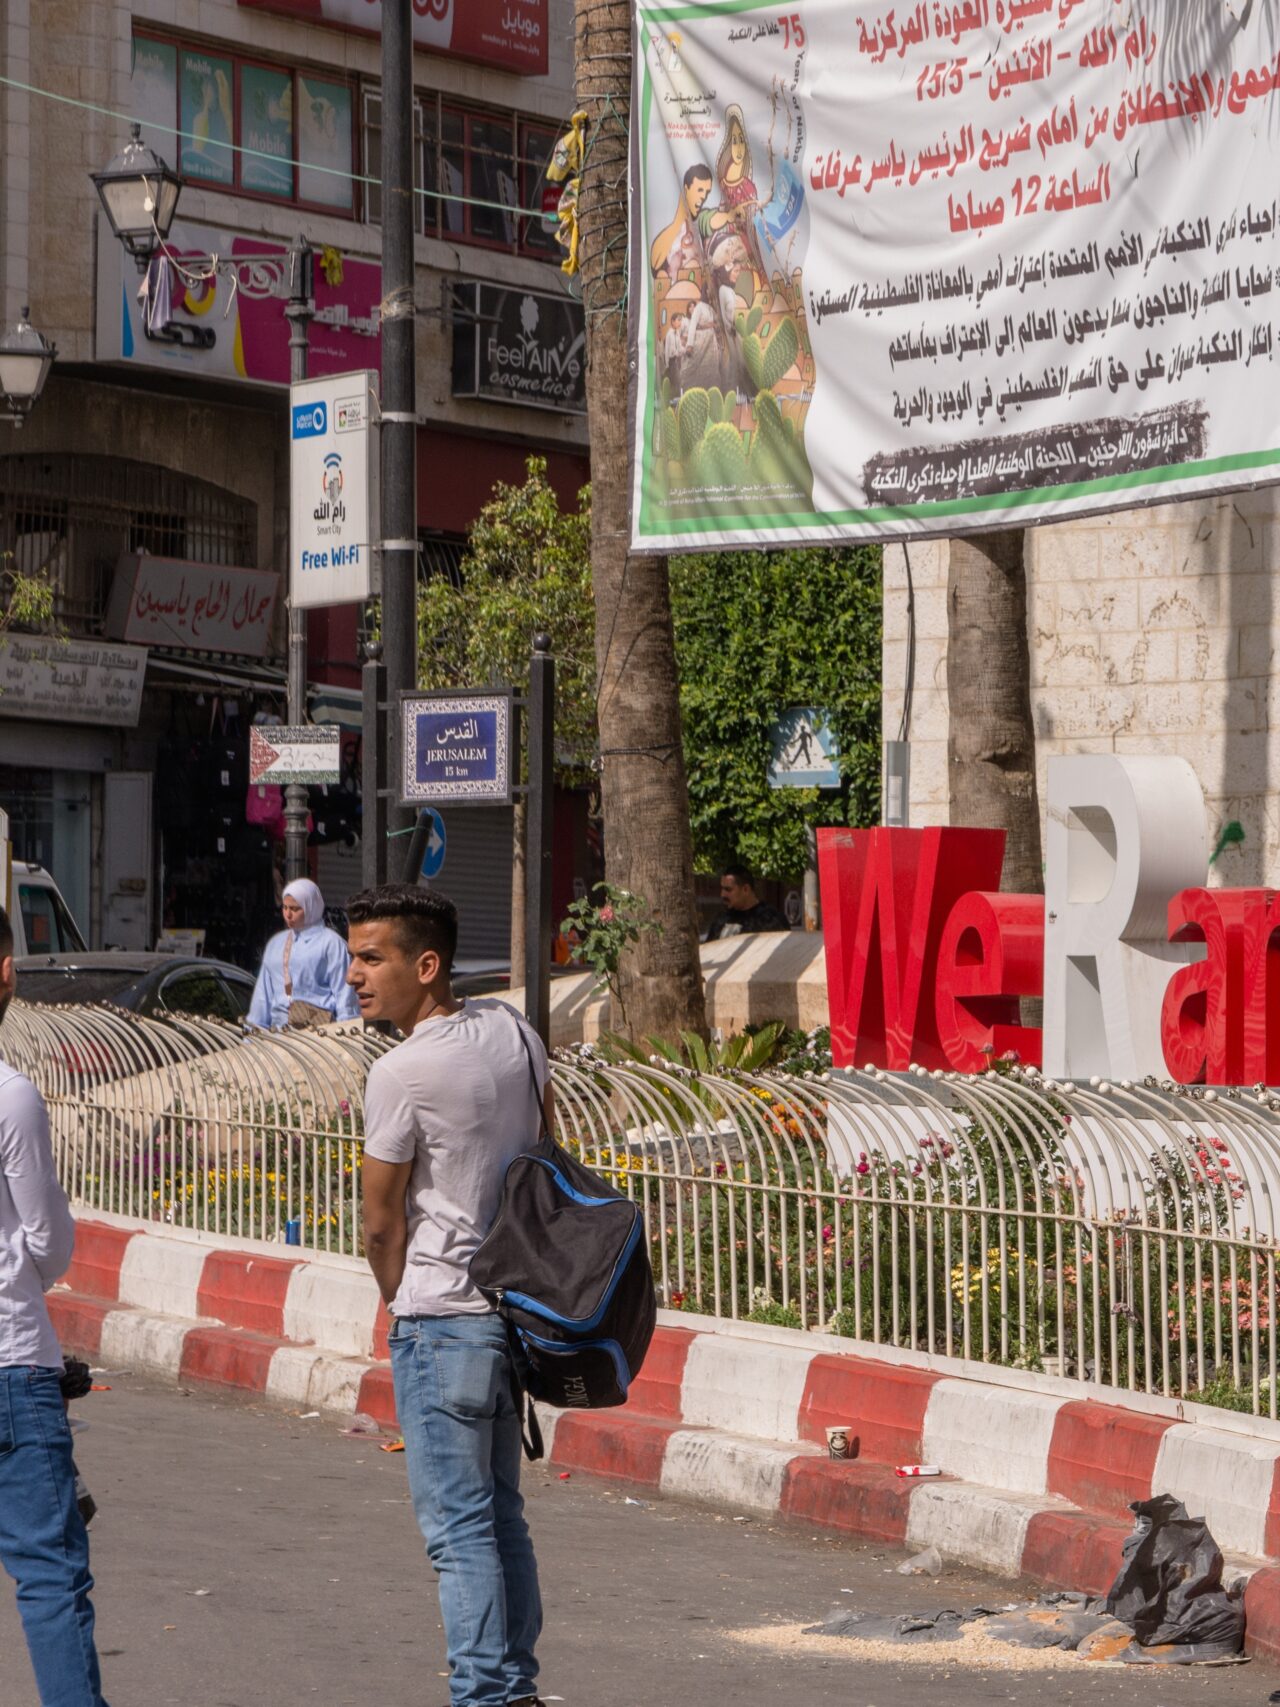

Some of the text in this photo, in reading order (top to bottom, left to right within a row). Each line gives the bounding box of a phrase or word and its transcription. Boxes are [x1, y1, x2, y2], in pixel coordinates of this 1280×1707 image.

[501, 8, 541, 37] موبايل
[778, 14, 805, 50] 75
[856, 3, 930, 62] المركزية
[935, 0, 989, 45] العودة
[1124, 16, 1157, 72] رام
[186, 59, 212, 76] Mobile
[1079, 24, 1117, 68] الله
[915, 57, 968, 101] 15/5
[791, 51, 805, 163] Years of Nakba
[1037, 96, 1078, 161] أمام
[1085, 104, 1109, 147] من
[250, 132, 288, 154] Mobile
[910, 123, 975, 187] الرئيس
[979, 116, 1032, 172] ضريح
[809, 150, 864, 198] عرفات
[865, 139, 906, 194] ياسر
[947, 163, 1111, 238] الساعة 12 صباحا
[1239, 200, 1277, 243] إحياء
[1049, 241, 1101, 280] المتحدة
[1104, 230, 1144, 281] الأمم
[1160, 216, 1212, 263] النكبة
[926, 264, 974, 302] بالمعاناة
[1005, 250, 1047, 293] إعتراف
[1235, 264, 1273, 306] ضحايا
[809, 281, 860, 325] المستمرة
[858, 271, 924, 317] الفلسطينية
[1134, 281, 1199, 329] والناجون
[940, 317, 991, 361] الإعتراف
[995, 314, 1015, 357] إلى
[1018, 308, 1058, 353] العالم
[1063, 306, 1109, 344] يدعون
[1245, 321, 1273, 367] إنكار
[487, 337, 526, 369] Feel
[1135, 348, 1165, 390] على
[1196, 328, 1243, 373] النكبة
[489, 371, 576, 396] cosmetics
[996, 365, 1068, 423] الفلسطيني
[1107, 355, 1130, 393] حق
[893, 386, 934, 427] والحرية
[937, 379, 973, 421] الوجود
[976, 376, 993, 425] في
[967, 454, 996, 484] العليا
[996, 446, 1035, 479] الوطنية
[1036, 440, 1077, 473] اللجنة
[1087, 431, 1133, 468] اللاجئين
[871, 467, 907, 492] النكبة
[905, 466, 935, 493] ذكرى
[313, 498, 346, 523] رام الله
[317, 525, 342, 536] Smart City
[302, 544, 360, 570] Free Wi-Fi
[136, 576, 272, 636] جمال الحاج ياسين
[436, 718, 479, 745] القدس
[425, 748, 488, 765] JERUSALEM
[445, 766, 469, 777] 15 km
[816, 826, 1043, 1070] We
